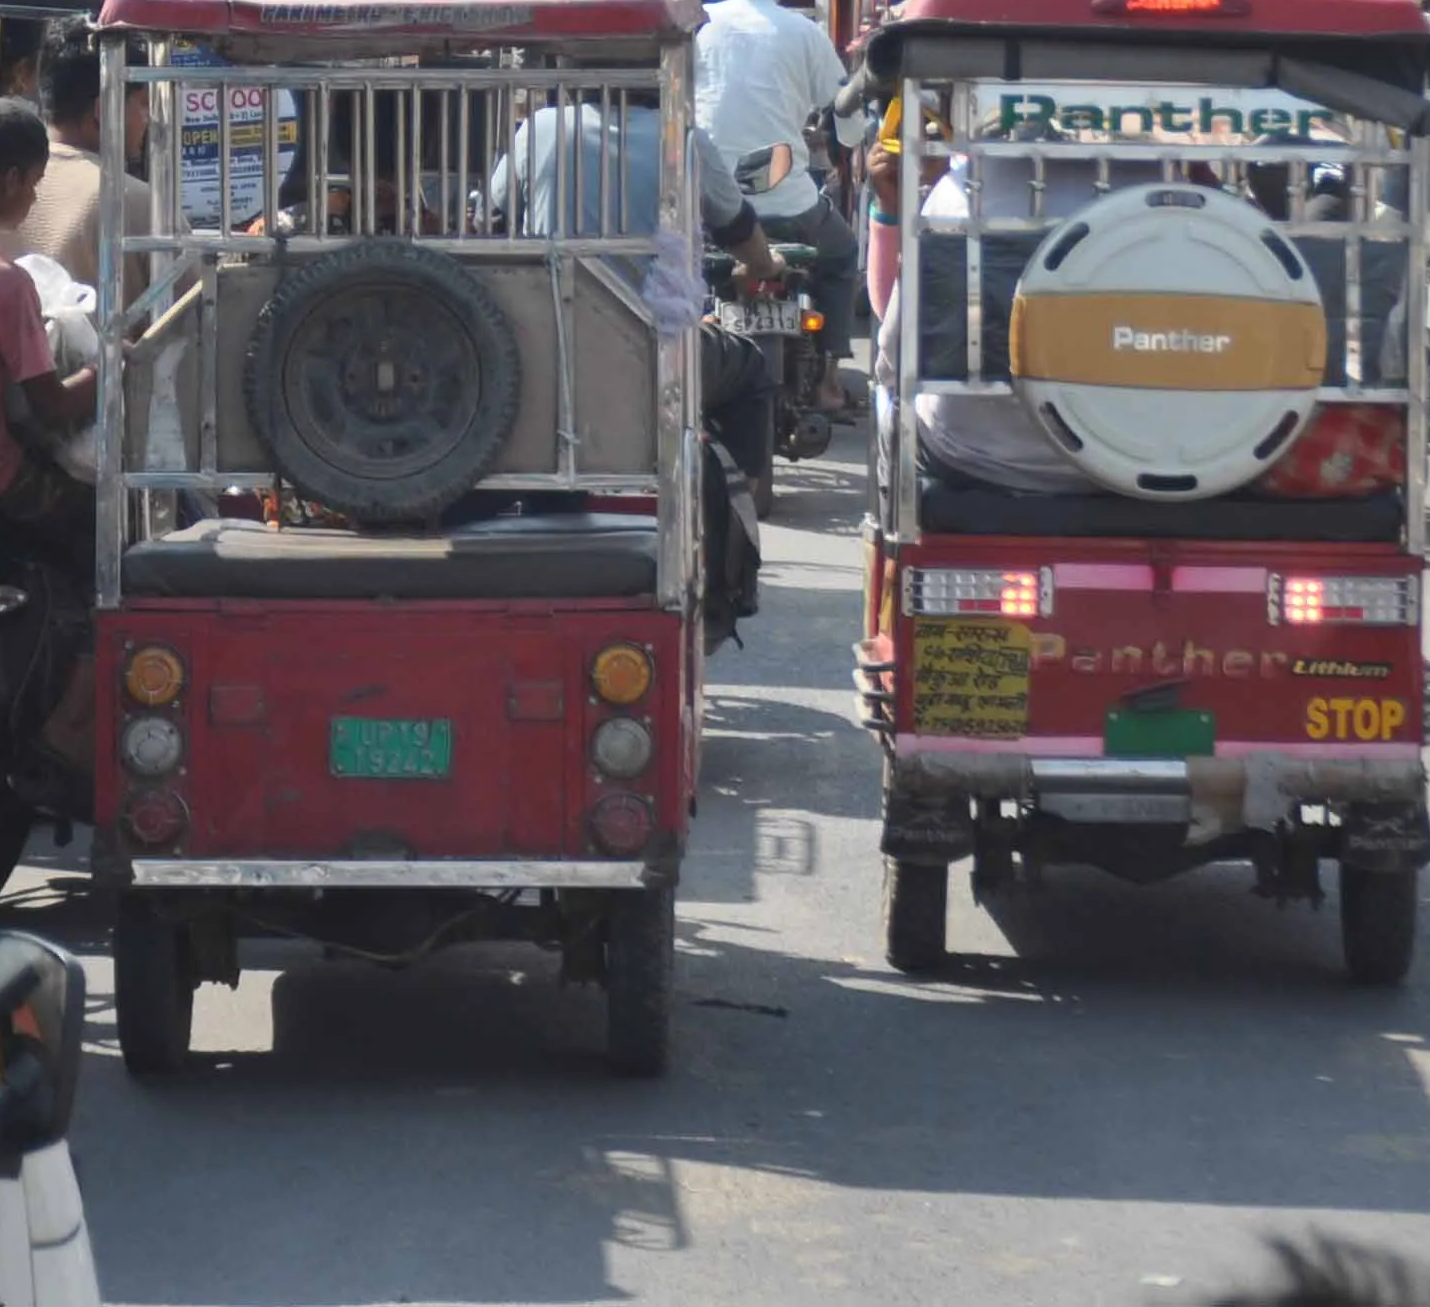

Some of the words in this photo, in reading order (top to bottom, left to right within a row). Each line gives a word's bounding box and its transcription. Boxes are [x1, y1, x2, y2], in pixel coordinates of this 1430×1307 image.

[185, 87, 267, 112] SCOO
[1113, 326, 1231, 353] Panther
[1030, 631, 1289, 679] Panther
[1305, 696, 1405, 742] STOP
